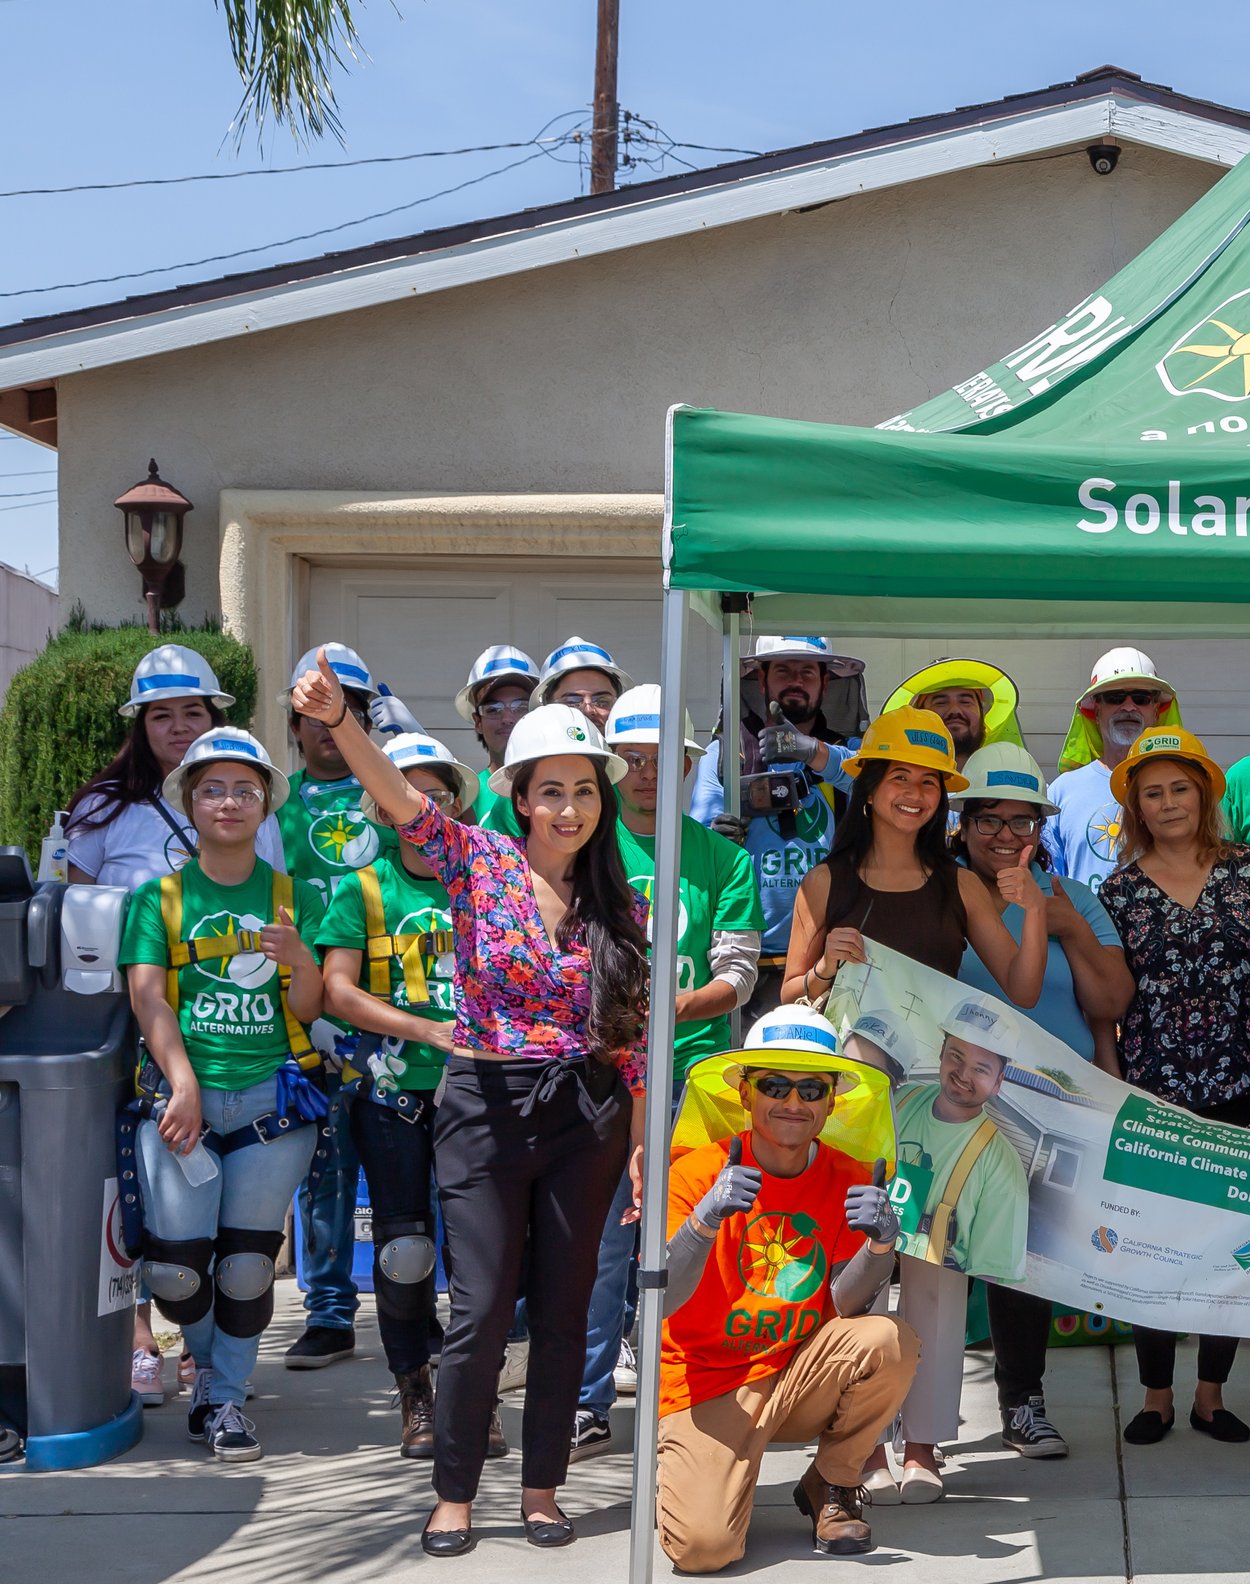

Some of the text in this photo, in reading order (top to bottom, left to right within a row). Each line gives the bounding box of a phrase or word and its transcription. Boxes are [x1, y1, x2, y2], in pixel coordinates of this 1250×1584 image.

[1140, 428, 1168, 441] a
[1154, 737, 1180, 746] GRID
[763, 878, 801, 888] ALTERN
[192, 991, 274, 1022] GRID
[190, 1021, 275, 1035] ALTERNATIVES
[1122, 1119, 1180, 1142] Climate
[1146, 1114, 1213, 1137] Strategic
[1115, 1137, 1188, 1167] California
[1190, 1156, 1248, 1181] Climate
[1100, 1201, 1141, 1217] FUNDED BY:
[1120, 1245, 1184, 1266] GROWTH COUNCIL
[1122, 1237, 1203, 1261] CALIFORNIA STRATEGIC
[725, 1309, 820, 1342] GRID
